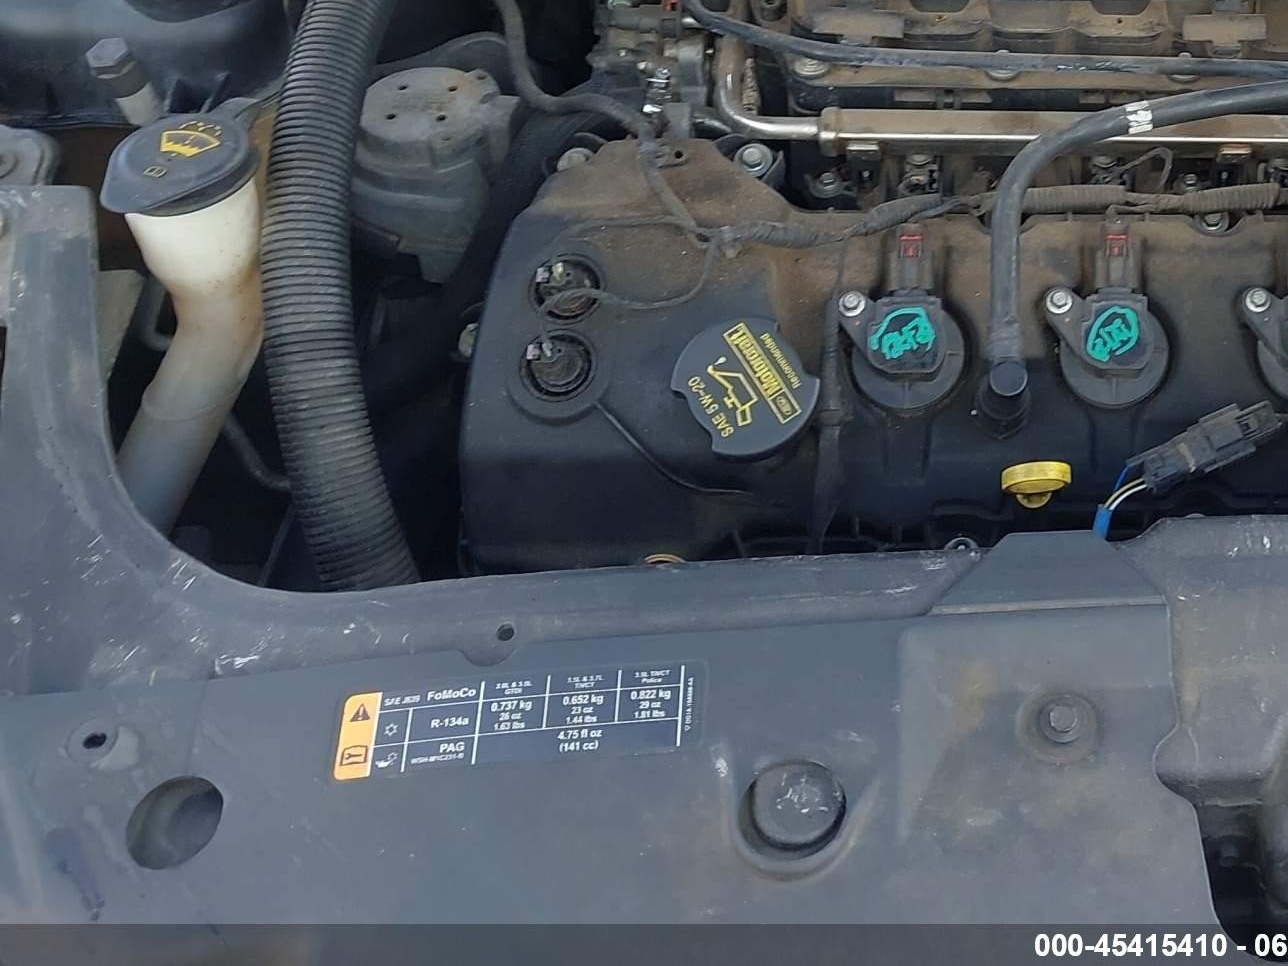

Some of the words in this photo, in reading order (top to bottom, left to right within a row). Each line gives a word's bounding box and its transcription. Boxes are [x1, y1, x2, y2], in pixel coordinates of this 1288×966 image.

[729, 326, 781, 398] Motorcraft
[760, 333, 802, 389] Recommended
[688, 376, 719, 414] 5W-20
[712, 412, 734, 437] SAE
[427, 687, 476, 701] FoMoCo
[562, 694, 589, 706] 0.652
[591, 694, 604, 705] kg
[630, 689, 656, 701] 0.822
[658, 688, 671, 700] kg
[491, 701, 517, 712] 0.737
[519, 700, 532, 711] kg
[570, 706, 581, 715] 23
[582, 706, 593, 714] oz
[639, 700, 650, 709] 29
[651, 701, 661, 709] oz
[511, 712, 522, 720] oz
[651, 709, 665, 718] lbs
[430, 716, 469, 728] R-134a
[512, 721, 525, 729] lbs
[566, 716, 583, 725] 1.44
[584, 715, 598, 723] lbs
[557, 729, 579, 740] 4.75
[581, 728, 588, 738] fl
[590, 729, 602, 738] oz
[440, 742, 465, 753] PAG
[559, 741, 580, 753] (141
[583, 740, 599, 751] cc)
